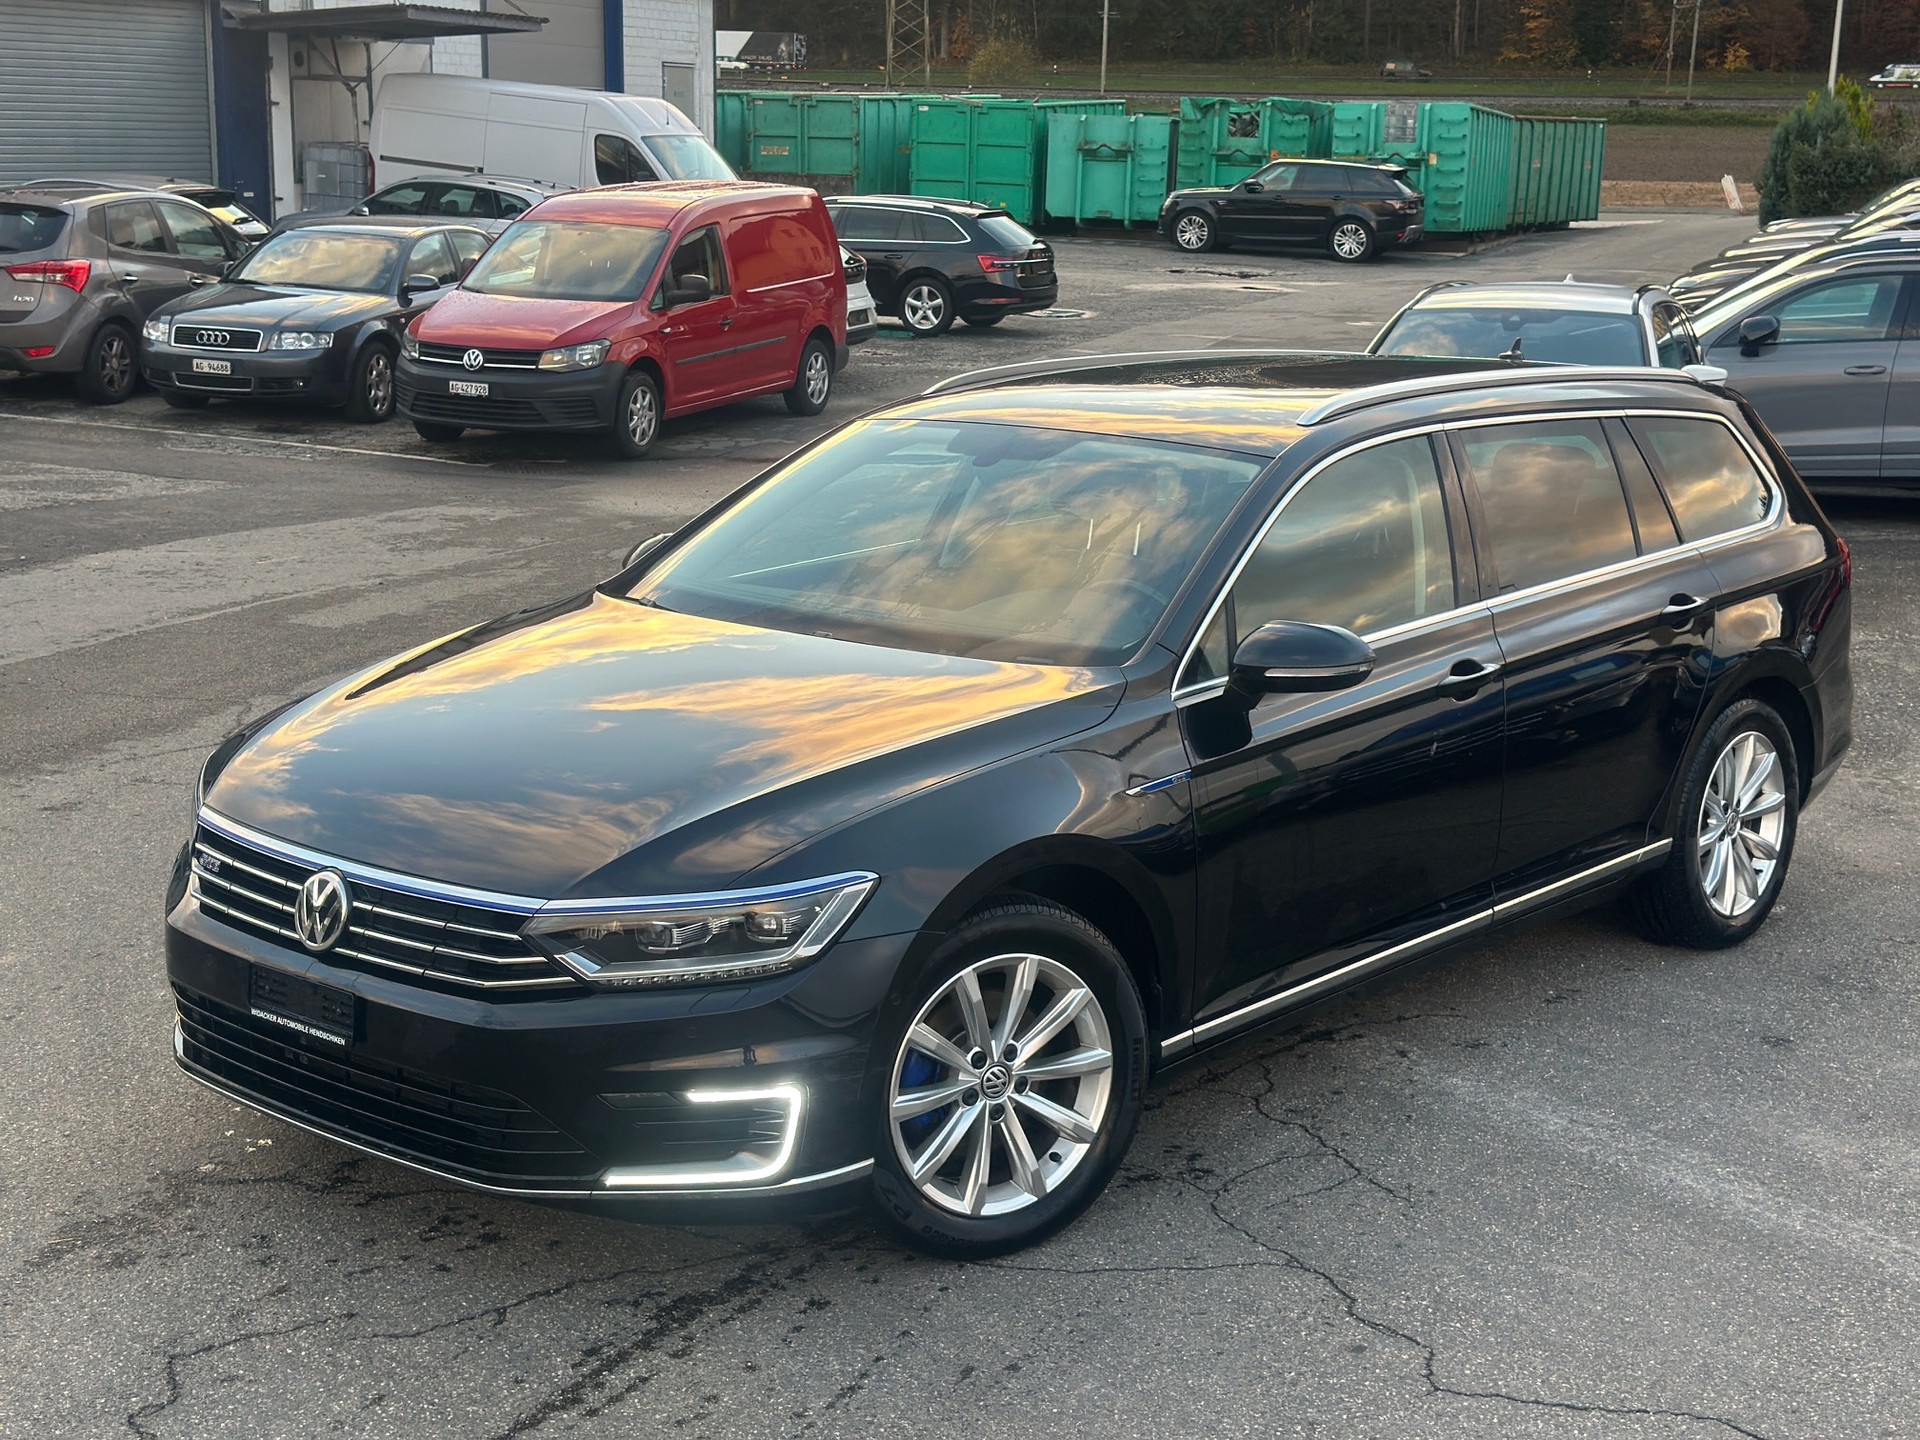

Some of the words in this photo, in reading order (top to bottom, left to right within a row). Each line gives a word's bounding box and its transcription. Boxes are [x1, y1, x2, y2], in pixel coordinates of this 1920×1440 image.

[195, 362, 205, 371] AG
[207, 362, 229, 373] 94688
[451, 382, 460, 392] AG
[295, 871, 348, 951] VW
[276, 1016, 309, 1034] AUTOMOBILE
[308, 1027, 346, 1046] HENDSCHIKEN
